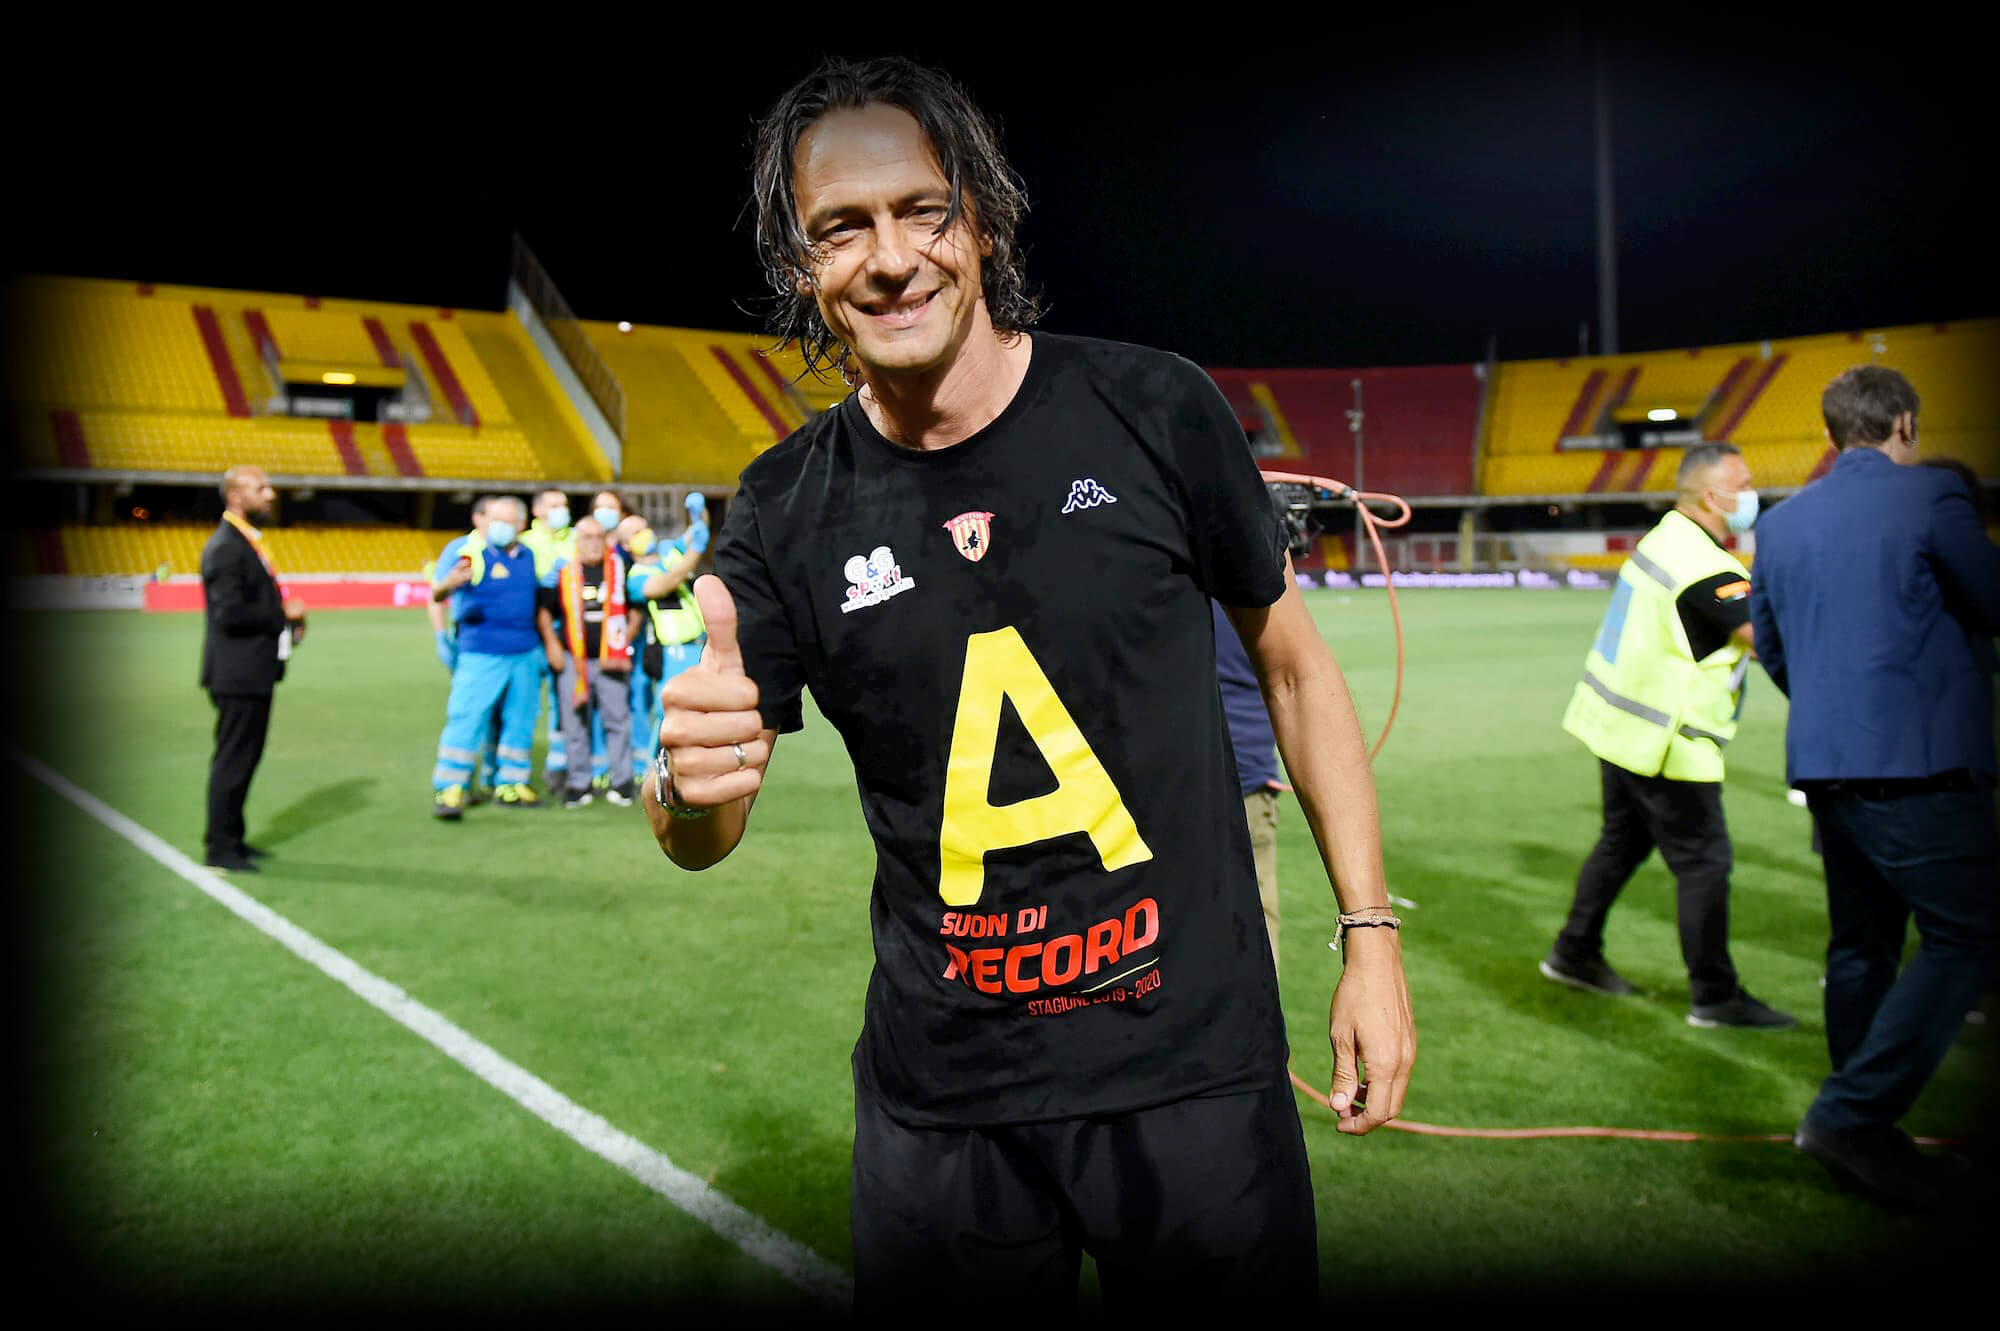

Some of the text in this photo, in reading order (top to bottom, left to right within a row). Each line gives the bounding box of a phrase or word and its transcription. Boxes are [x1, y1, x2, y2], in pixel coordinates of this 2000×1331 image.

[938, 625, 1154, 906] A
[940, 905, 1048, 939] SUON DI
[942, 897, 1160, 994] RECORD
[1135, 968, 1162, 999] 2020
